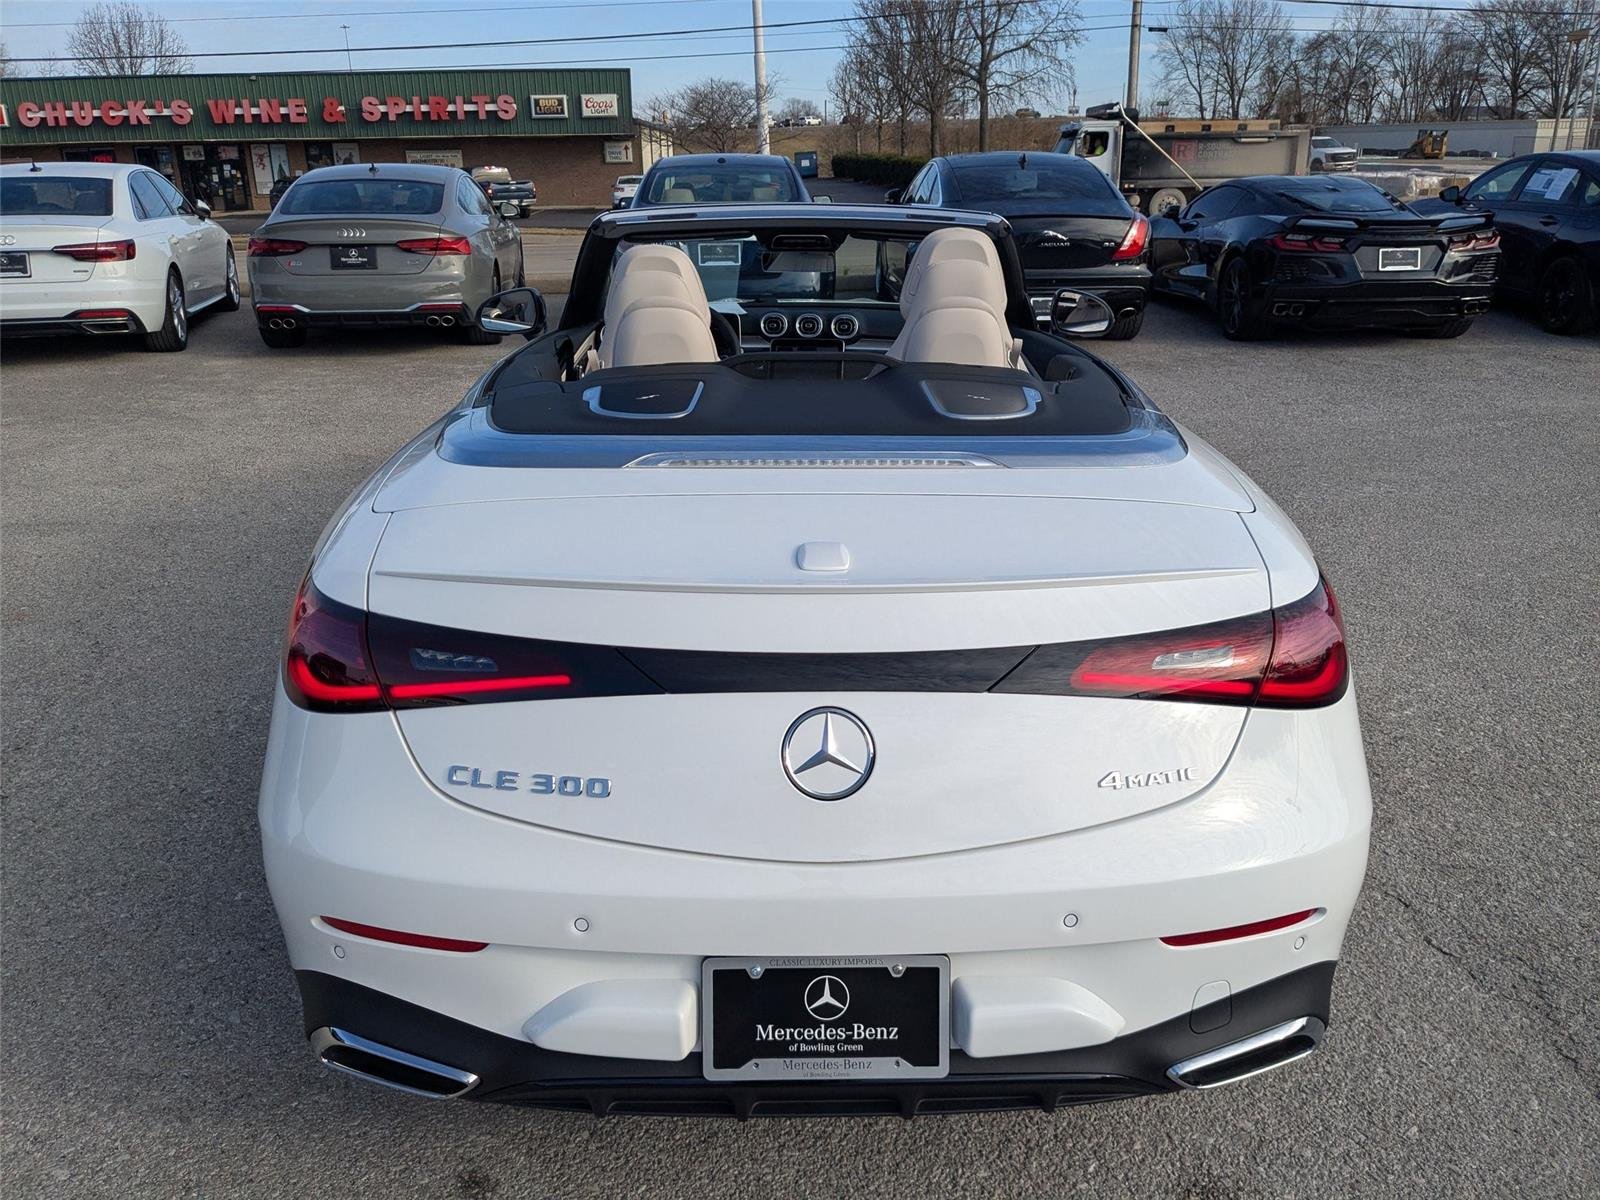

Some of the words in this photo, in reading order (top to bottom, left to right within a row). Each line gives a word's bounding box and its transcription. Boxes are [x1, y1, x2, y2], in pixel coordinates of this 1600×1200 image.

[539, 98, 558, 106] BUD
[585, 97, 613, 109] Coors
[17, 98, 193, 128] CHUCK'S
[207, 97, 309, 125] WINE
[323, 96, 346, 123] &
[361, 94, 517, 122] SPIRITS
[447, 765, 521, 791] CLE
[528, 773, 612, 798] 300
[1097, 767, 1199, 790] 4MATIC
[769, 959, 804, 967] CLASSIC
[806, 958, 842, 966] LUXURY
[844, 958, 884, 966] IMPORTS
[755, 1023, 899, 1041] Mercedes-Benz
[788, 1043, 798, 1052] of
[800, 1043, 835, 1054] Bowling
[837, 1043, 864, 1052] Green
[782, 1059, 872, 1071] Mercedes-Benz
[810, 1071, 832, 1079] Bowling
